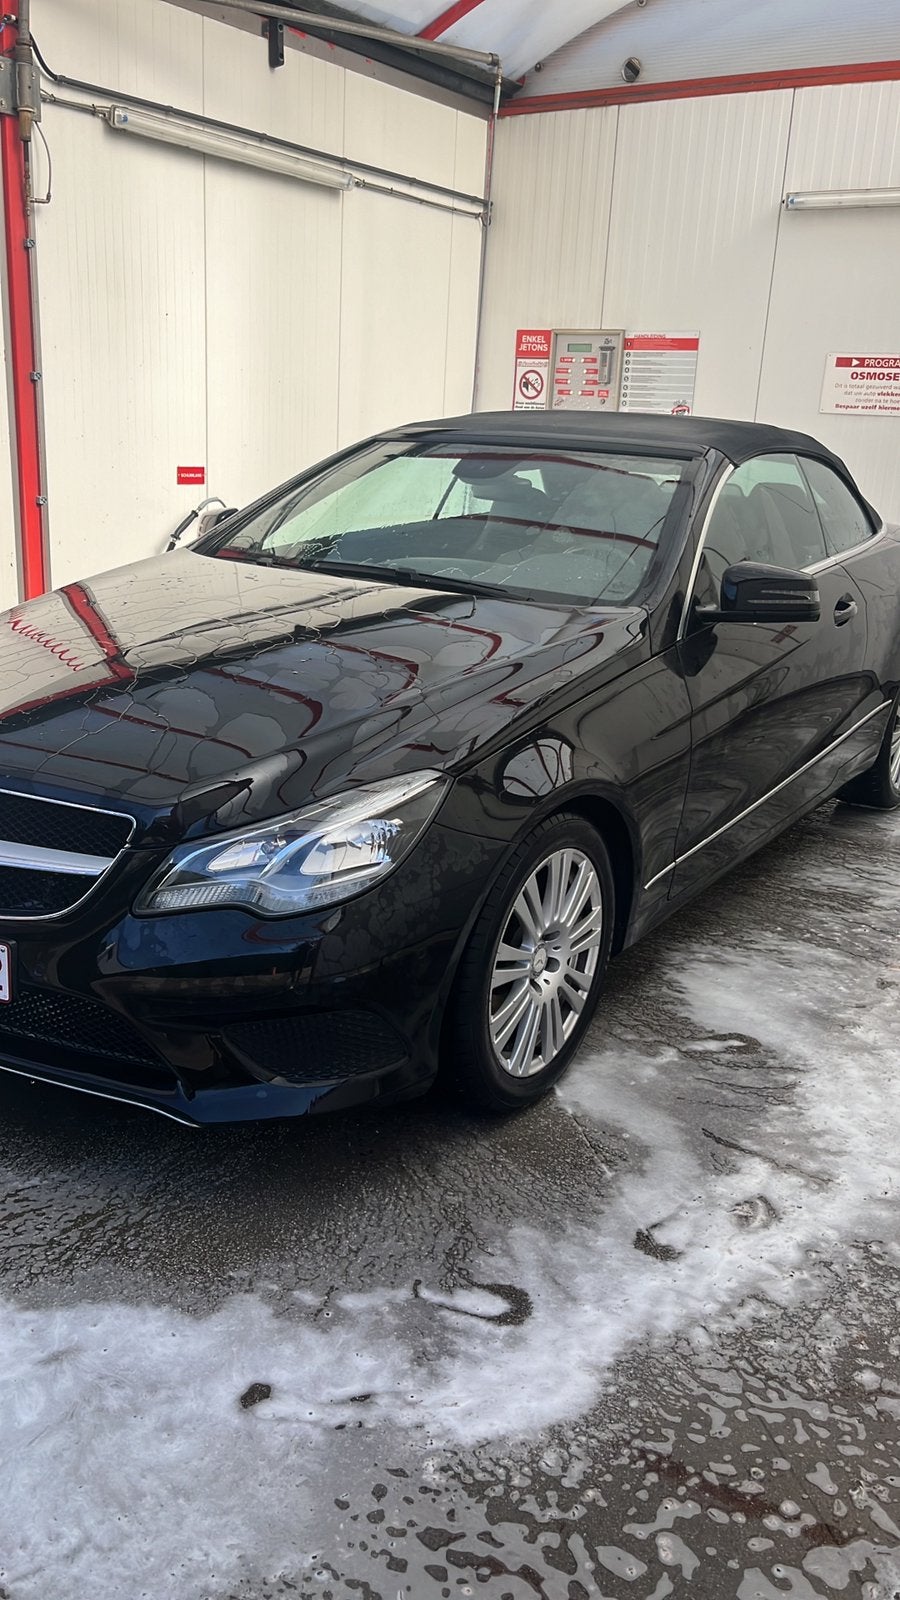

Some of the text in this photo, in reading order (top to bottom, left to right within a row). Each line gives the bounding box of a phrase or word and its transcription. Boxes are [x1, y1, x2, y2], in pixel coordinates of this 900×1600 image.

[521, 335, 546, 343] ENKEL
[518, 343, 548, 351] JETONS
[864, 359, 900, 367] PROGRA
[850, 371, 900, 381] OSMOSE
